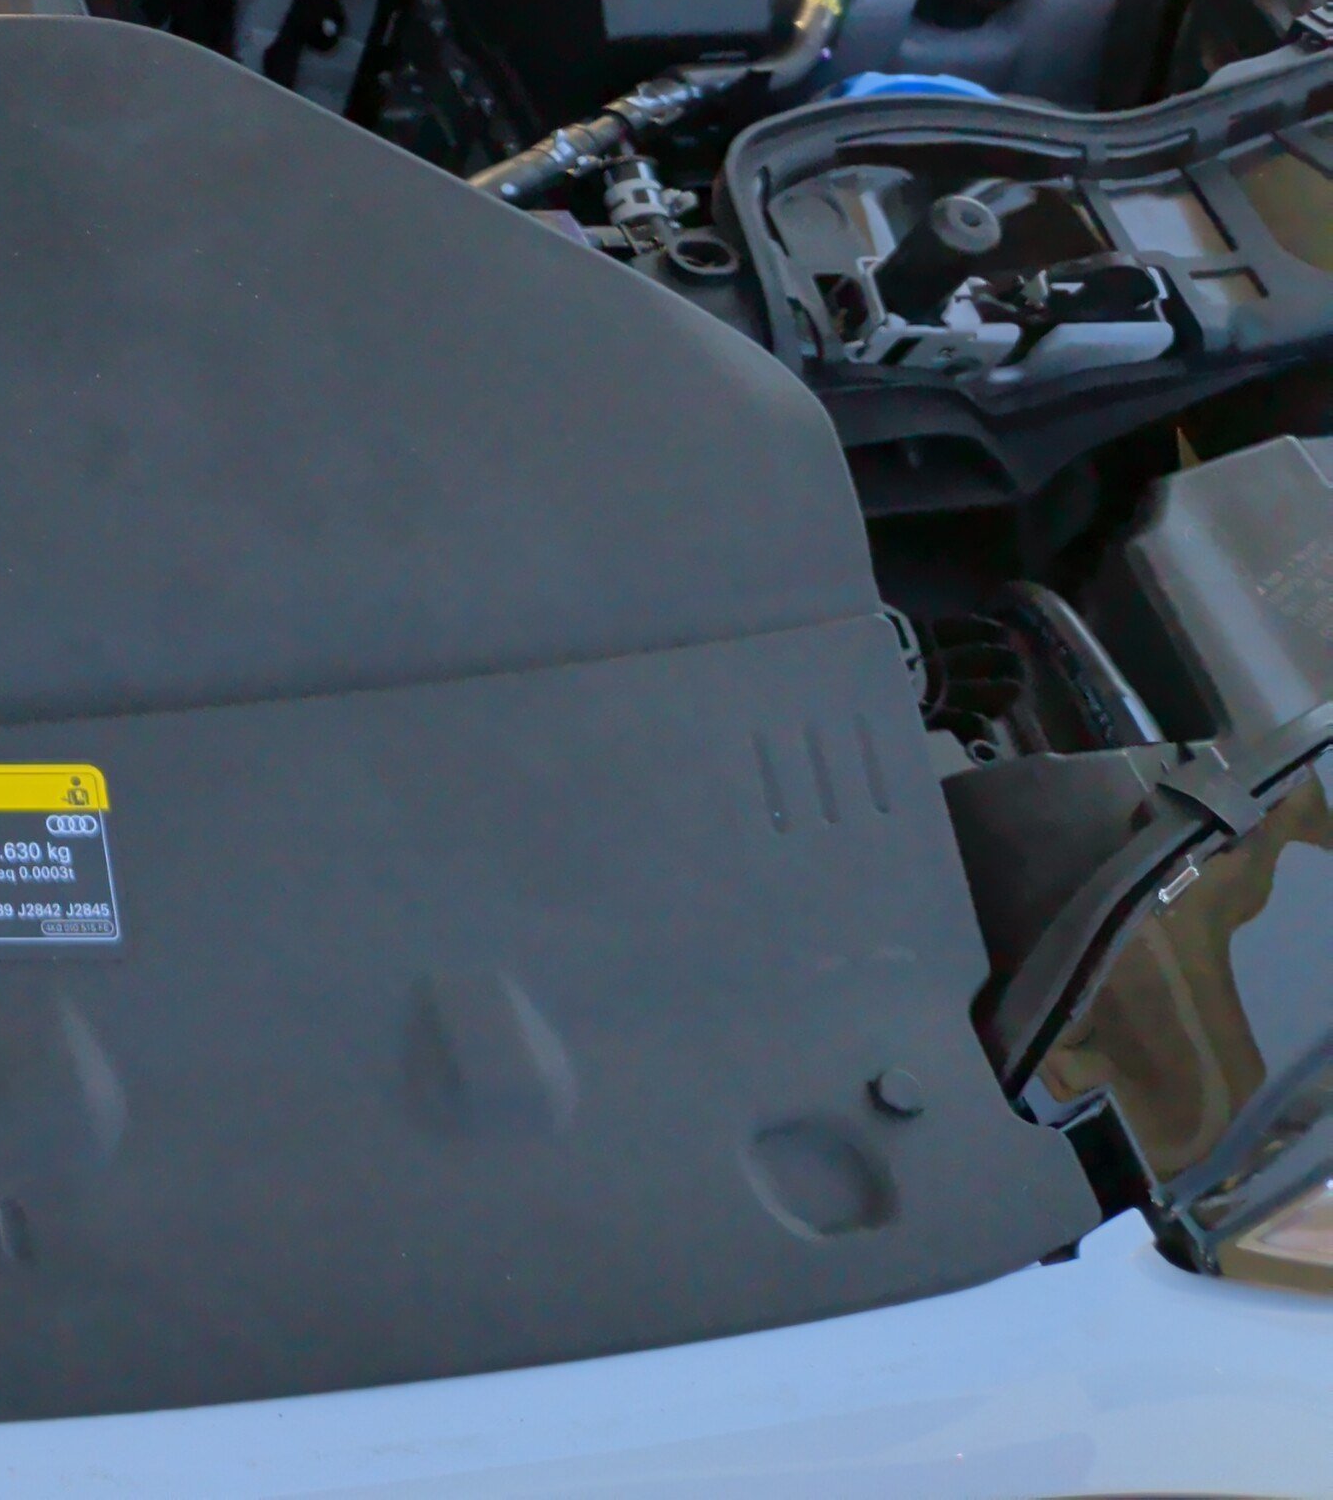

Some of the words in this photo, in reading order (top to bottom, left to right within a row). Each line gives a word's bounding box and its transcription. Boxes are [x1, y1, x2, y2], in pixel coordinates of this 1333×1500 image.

[47, 841, 71, 863] kg
[19, 865, 75, 882] 0.0003t
[18, 902, 61, 918] J2842
[66, 902, 110, 917] J2845
